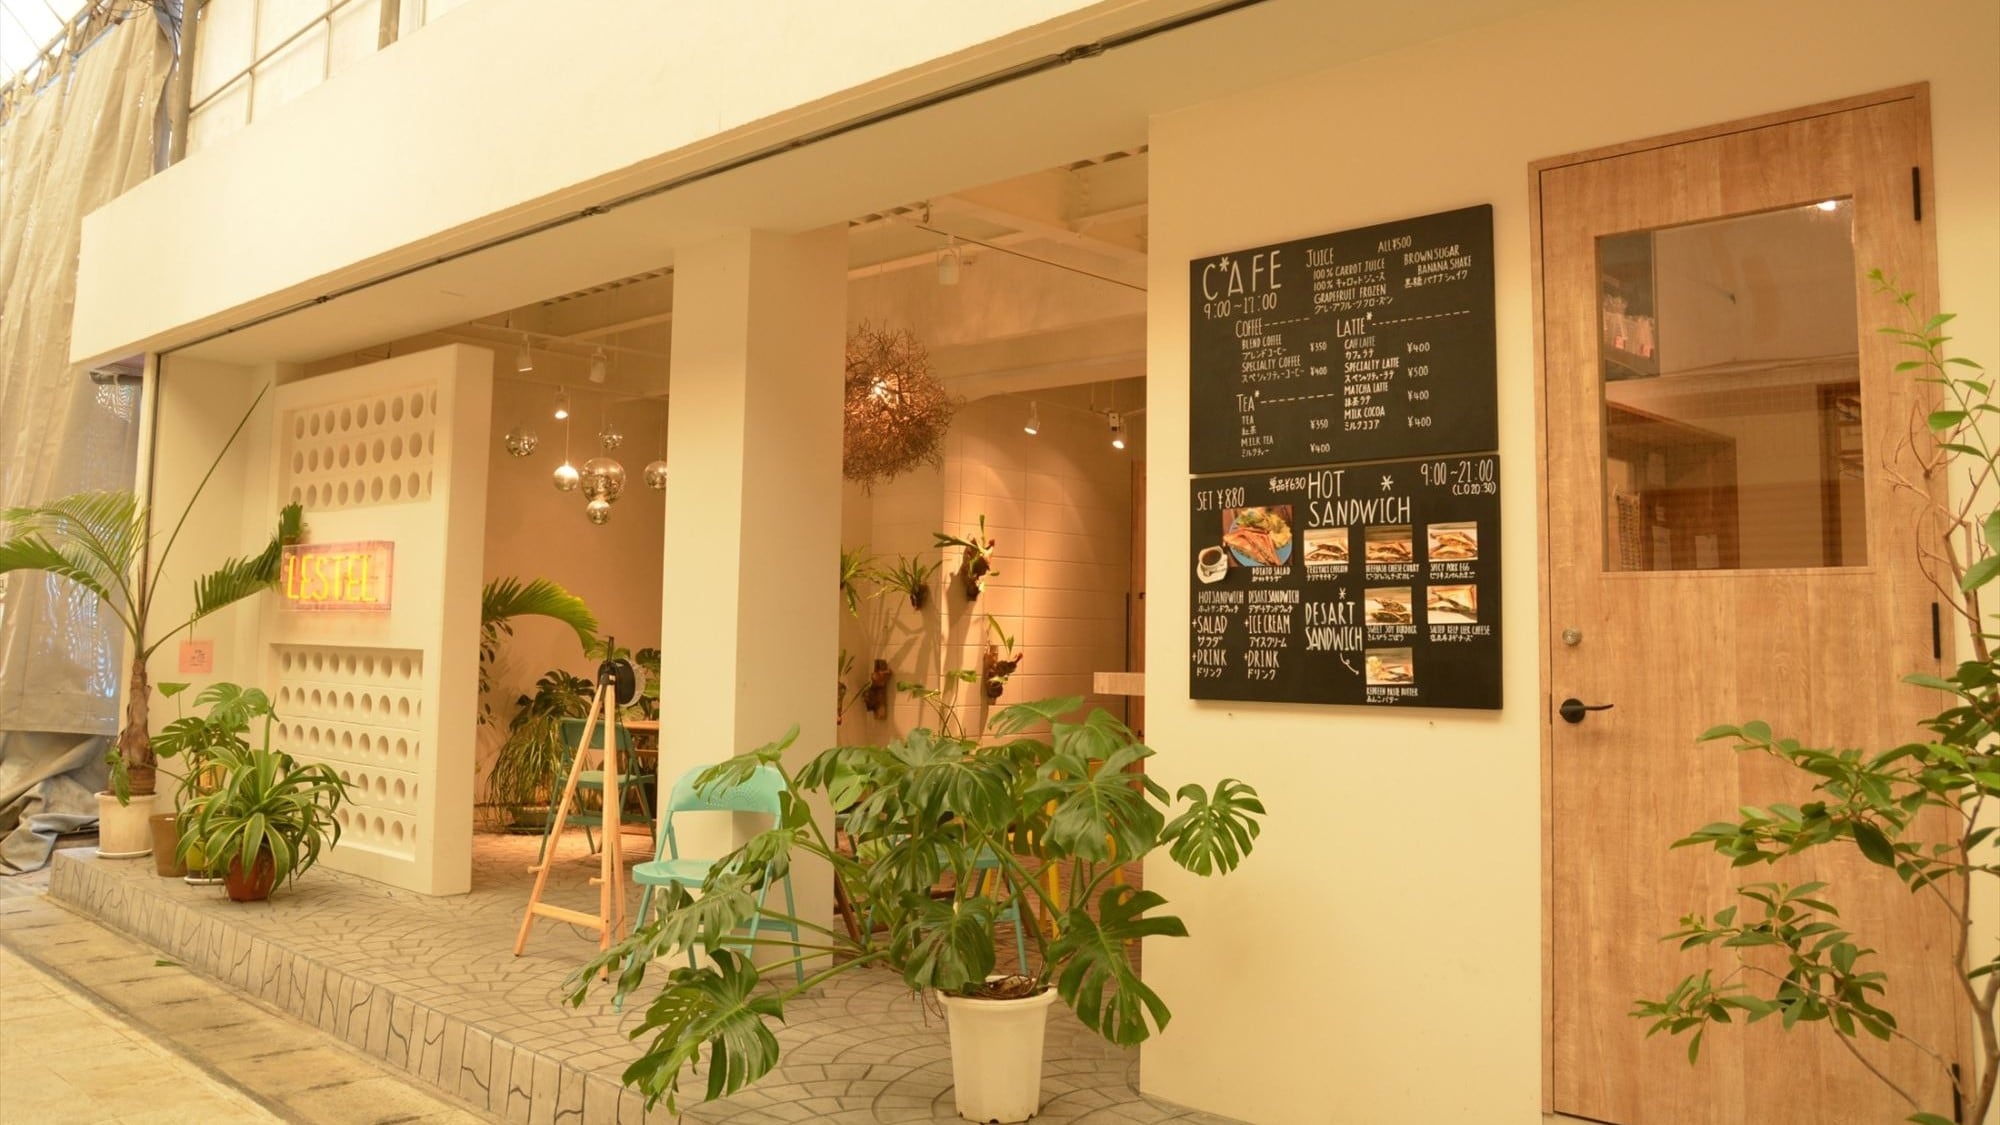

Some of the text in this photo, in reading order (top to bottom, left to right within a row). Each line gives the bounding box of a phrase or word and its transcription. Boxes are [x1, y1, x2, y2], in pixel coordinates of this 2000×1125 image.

[1306, 248, 1334, 268] JUICE
[1417, 255, 1472, 275] BANANA SHAKE
[1335, 262, 1362, 277] CARROT
[1364, 257, 1385, 273] JUICE
[1314, 283, 1387, 304] GRAPEFRUIT FROZEN
[1235, 318, 1263, 338] COFFEE
[1336, 317, 1366, 338] LATTE
[1406, 341, 1431, 353] ¥400
[1381, 356, 1400, 370] LATTE
[1407, 365, 1429, 378] ¥500
[1344, 381, 1388, 396] MATCHA LATTE
[1407, 390, 1430, 402] ¥400
[1236, 393, 1256, 413] TEA
[1344, 405, 1386, 420] MILK COCOA
[1241, 415, 1255, 426] TEA
[1310, 418, 1329, 431] ¥350
[1344, 419, 1381, 432] ミルクココア
[1407, 416, 1432, 428] ¥400
[1240, 434, 1274, 448] MILK TEA
[1309, 443, 1331, 454] ¥400
[1307, 470, 1345, 500] HOT
[1196, 486, 1245, 512] SET ¥880
[1307, 495, 1411, 528] SANDWICH
[287, 552, 378, 602] LESTEL
[1252, 566, 1291, 576] POTATO SALAD
[1305, 601, 1355, 626] DESART
[1263, 614, 1291, 634] CREAM
[1197, 635, 1224, 648] サラダ
[1249, 636, 1287, 648] アイスクリーム
[1305, 626, 1363, 652] SANDWICH
[1196, 666, 1223, 678] ドリンク
[1247, 668, 1276, 680] ドリンク
